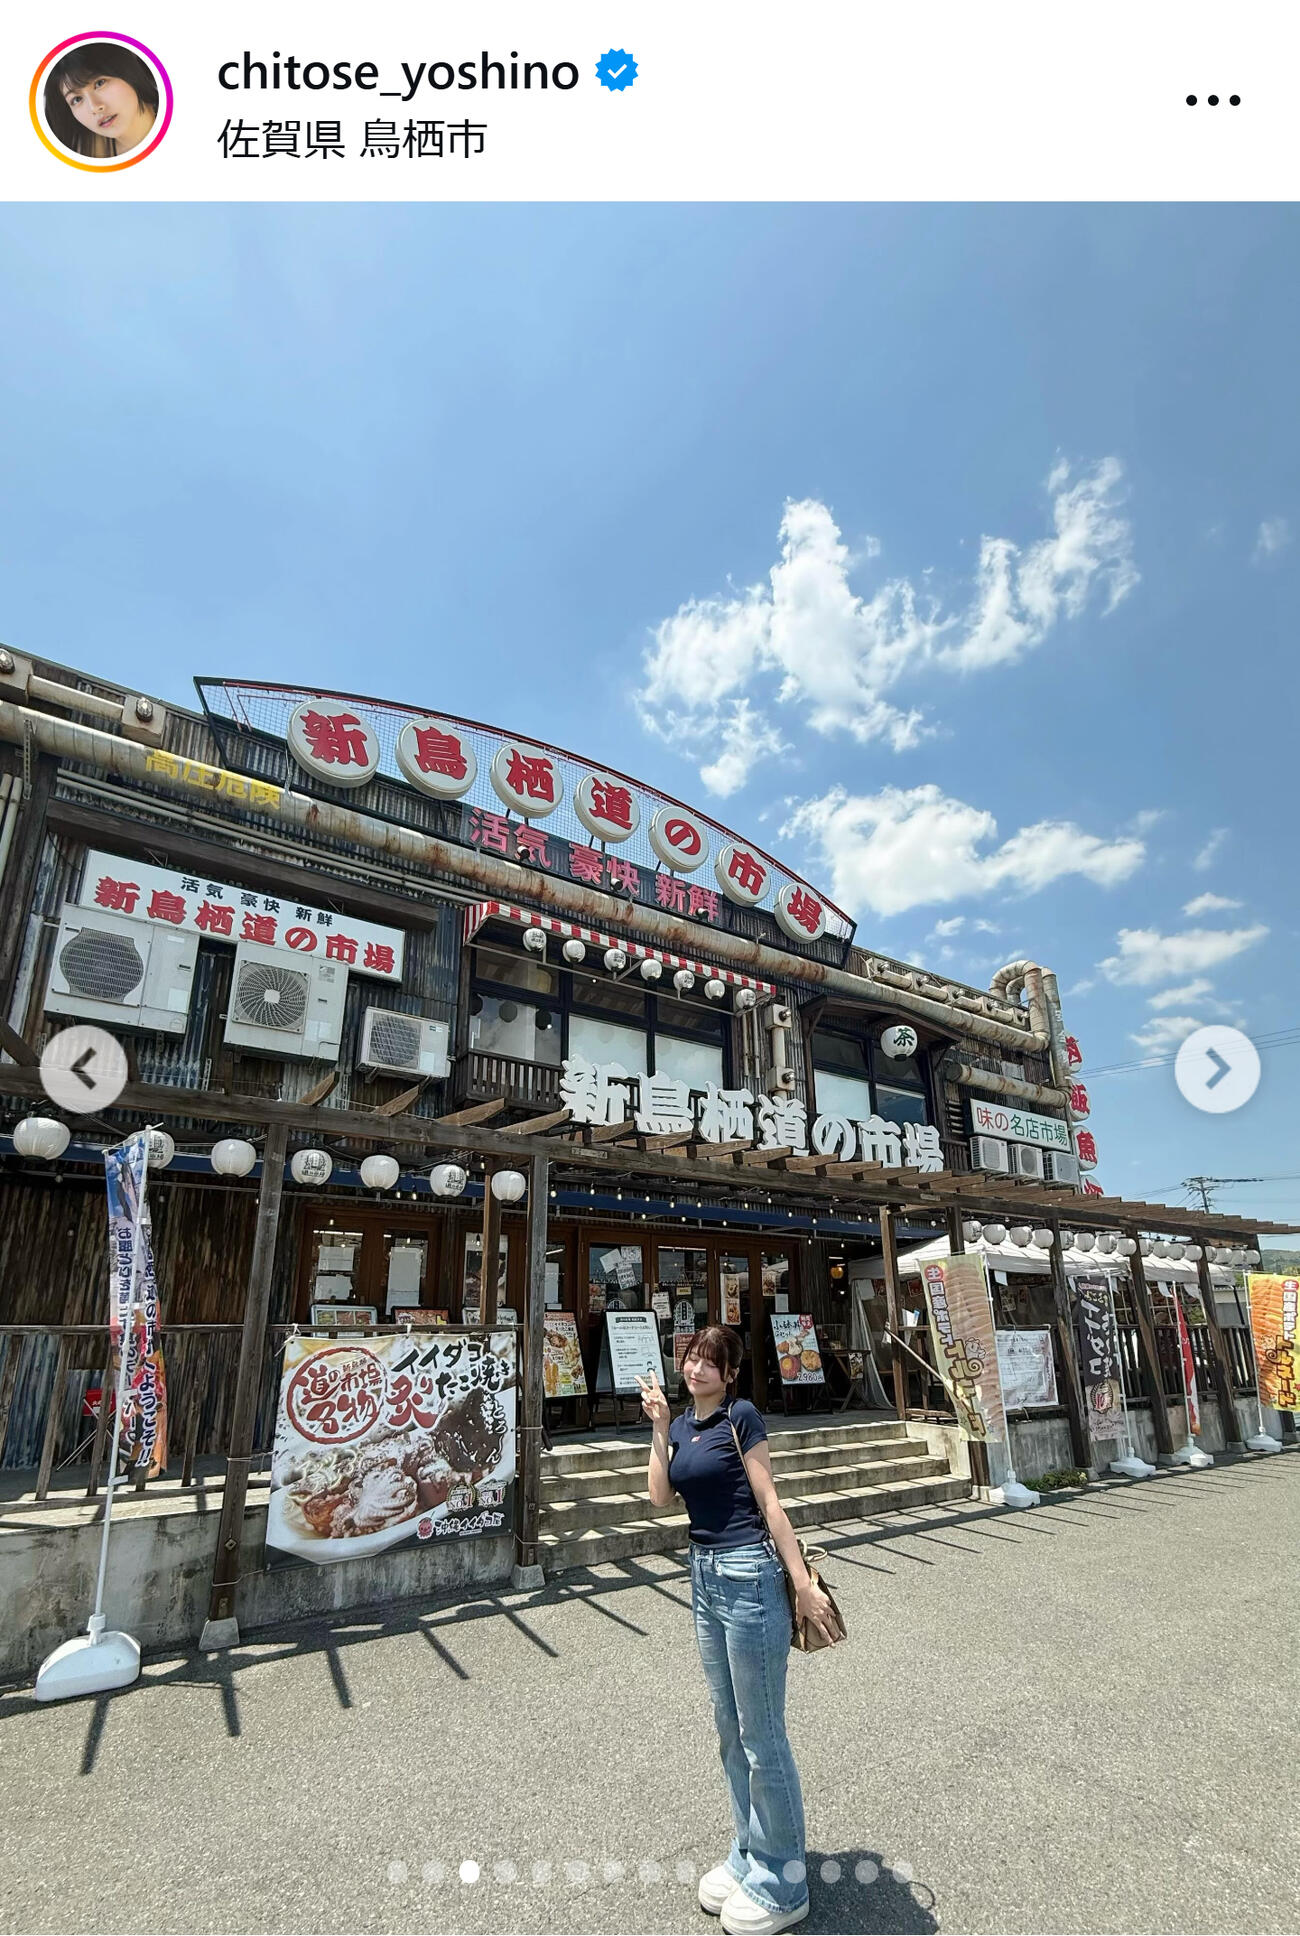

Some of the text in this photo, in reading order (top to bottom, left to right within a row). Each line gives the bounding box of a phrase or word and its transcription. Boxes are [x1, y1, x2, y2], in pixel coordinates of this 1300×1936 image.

[145, 749, 281, 810] 高圧危険
[300, 709, 826, 934] 新鳥栖道の市場
[469, 807, 722, 923] 活気 豪快 新鮮
[95, 875, 396, 974] 新鳥栖道の市場
[180, 876, 333, 927] 活気 豪快 新鮮
[893, 1026, 914, 1047] 茶
[560, 1053, 945, 1173] 新鳥栖道の市場
[976, 1107, 1068, 1146] 味の名店市場
[1076, 1130, 1098, 1164] 魚
[391, 1338, 485, 1376] イイダコ
[301, 1362, 383, 1405] 道の市場
